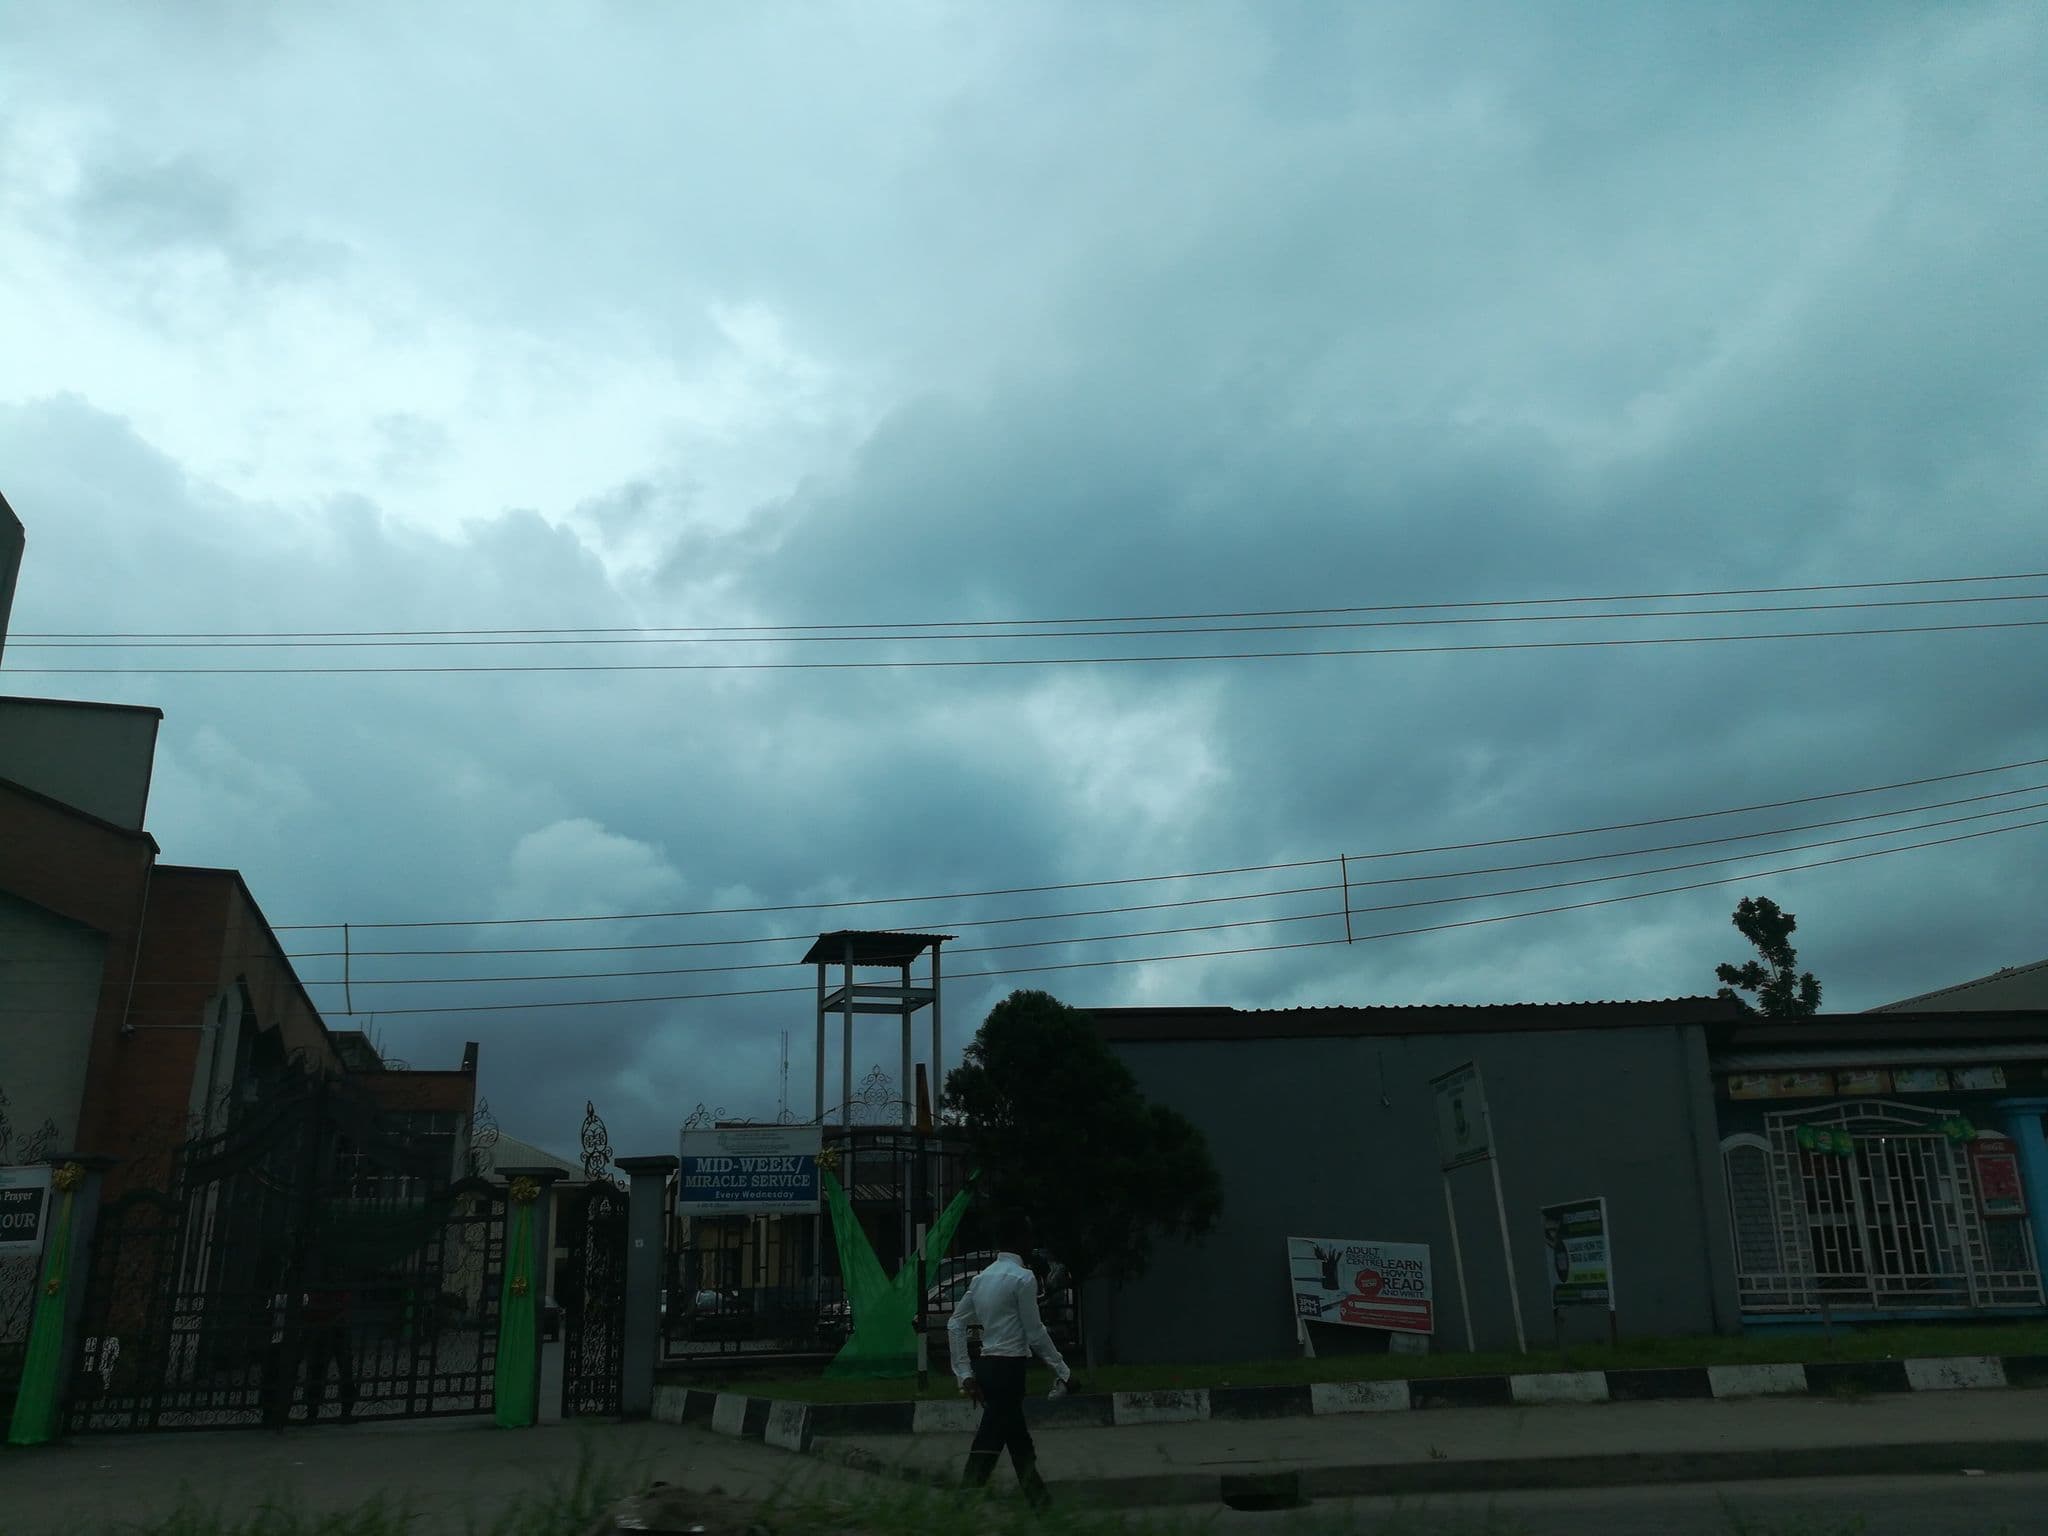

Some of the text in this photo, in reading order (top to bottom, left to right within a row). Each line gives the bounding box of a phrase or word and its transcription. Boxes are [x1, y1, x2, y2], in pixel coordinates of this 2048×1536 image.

[695, 1157, 805, 1174] MID-WEEK/
[685, 1174, 811, 1188] MIRACLE SERVICE
[4, 1191, 33, 1203] Prayer
[715, 1190, 795, 1200] Every Wednesday
[0, 1213, 36, 1229] OUR
[1345, 1246, 1380, 1256] ADULT
[1346, 1259, 1381, 1267] CENTRE
[1380, 1260, 1423, 1271] LEARN
[1381, 1269, 1423, 1280] HOW TO
[1383, 1278, 1425, 1291] READ
[1382, 1289, 1425, 1298] AND WRITE
